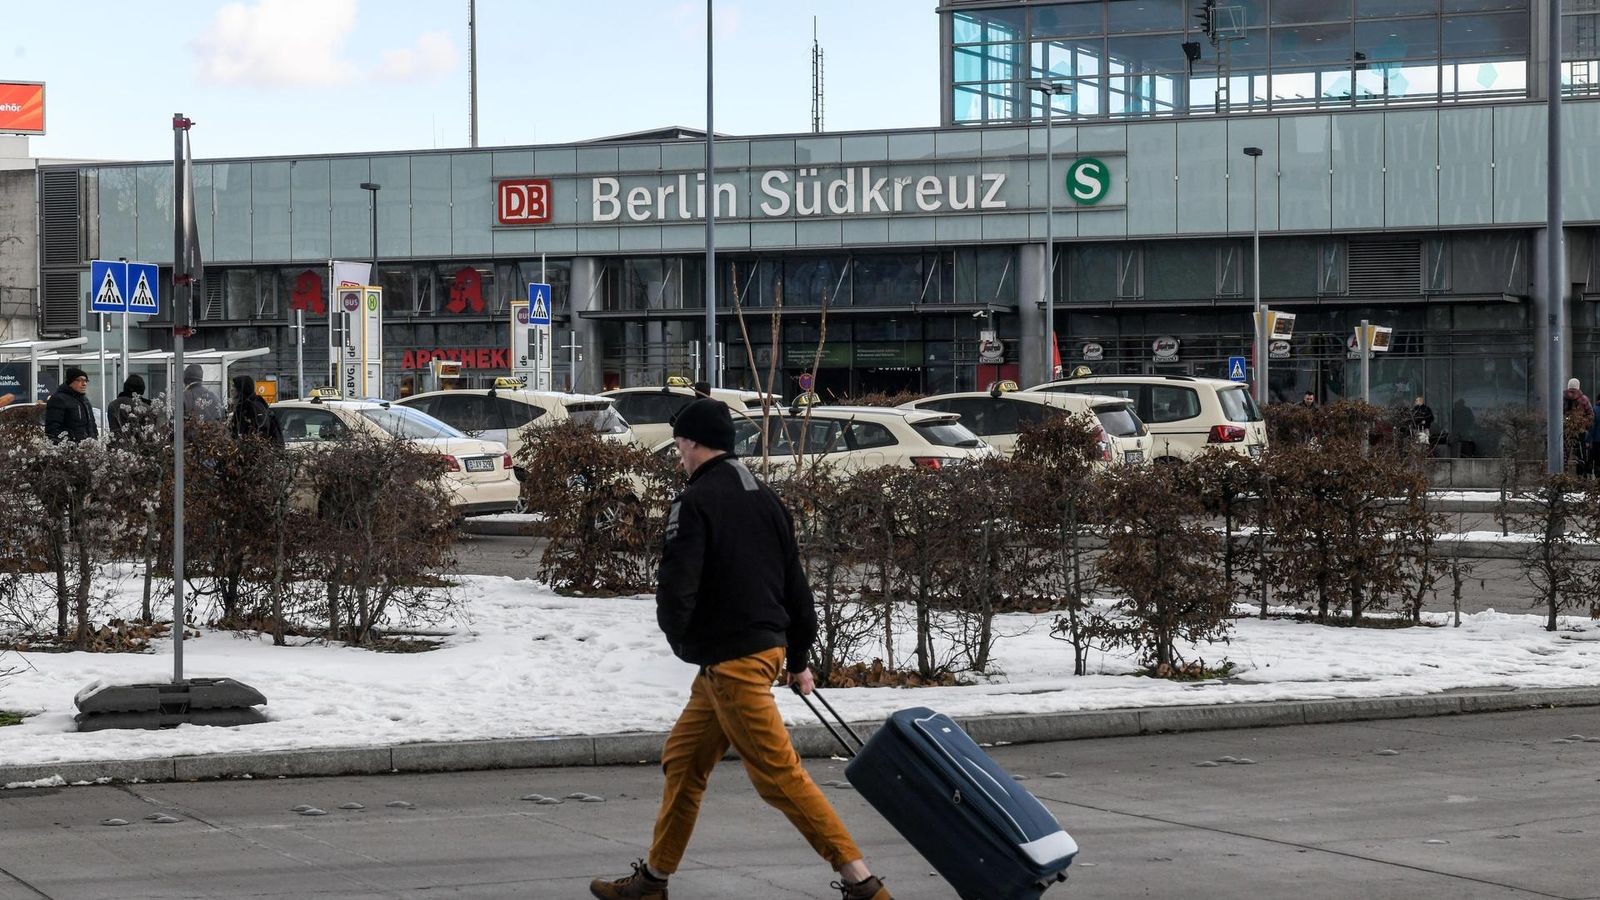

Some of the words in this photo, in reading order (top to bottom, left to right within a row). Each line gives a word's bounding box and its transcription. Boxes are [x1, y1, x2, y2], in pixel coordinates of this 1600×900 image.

[592, 173, 736, 221] Berlin
[760, 167, 1006, 217] Südkreuz
[1073, 163, 1101, 200] S
[502, 184, 548, 219] DB
[344, 298, 358, 306] BUS
